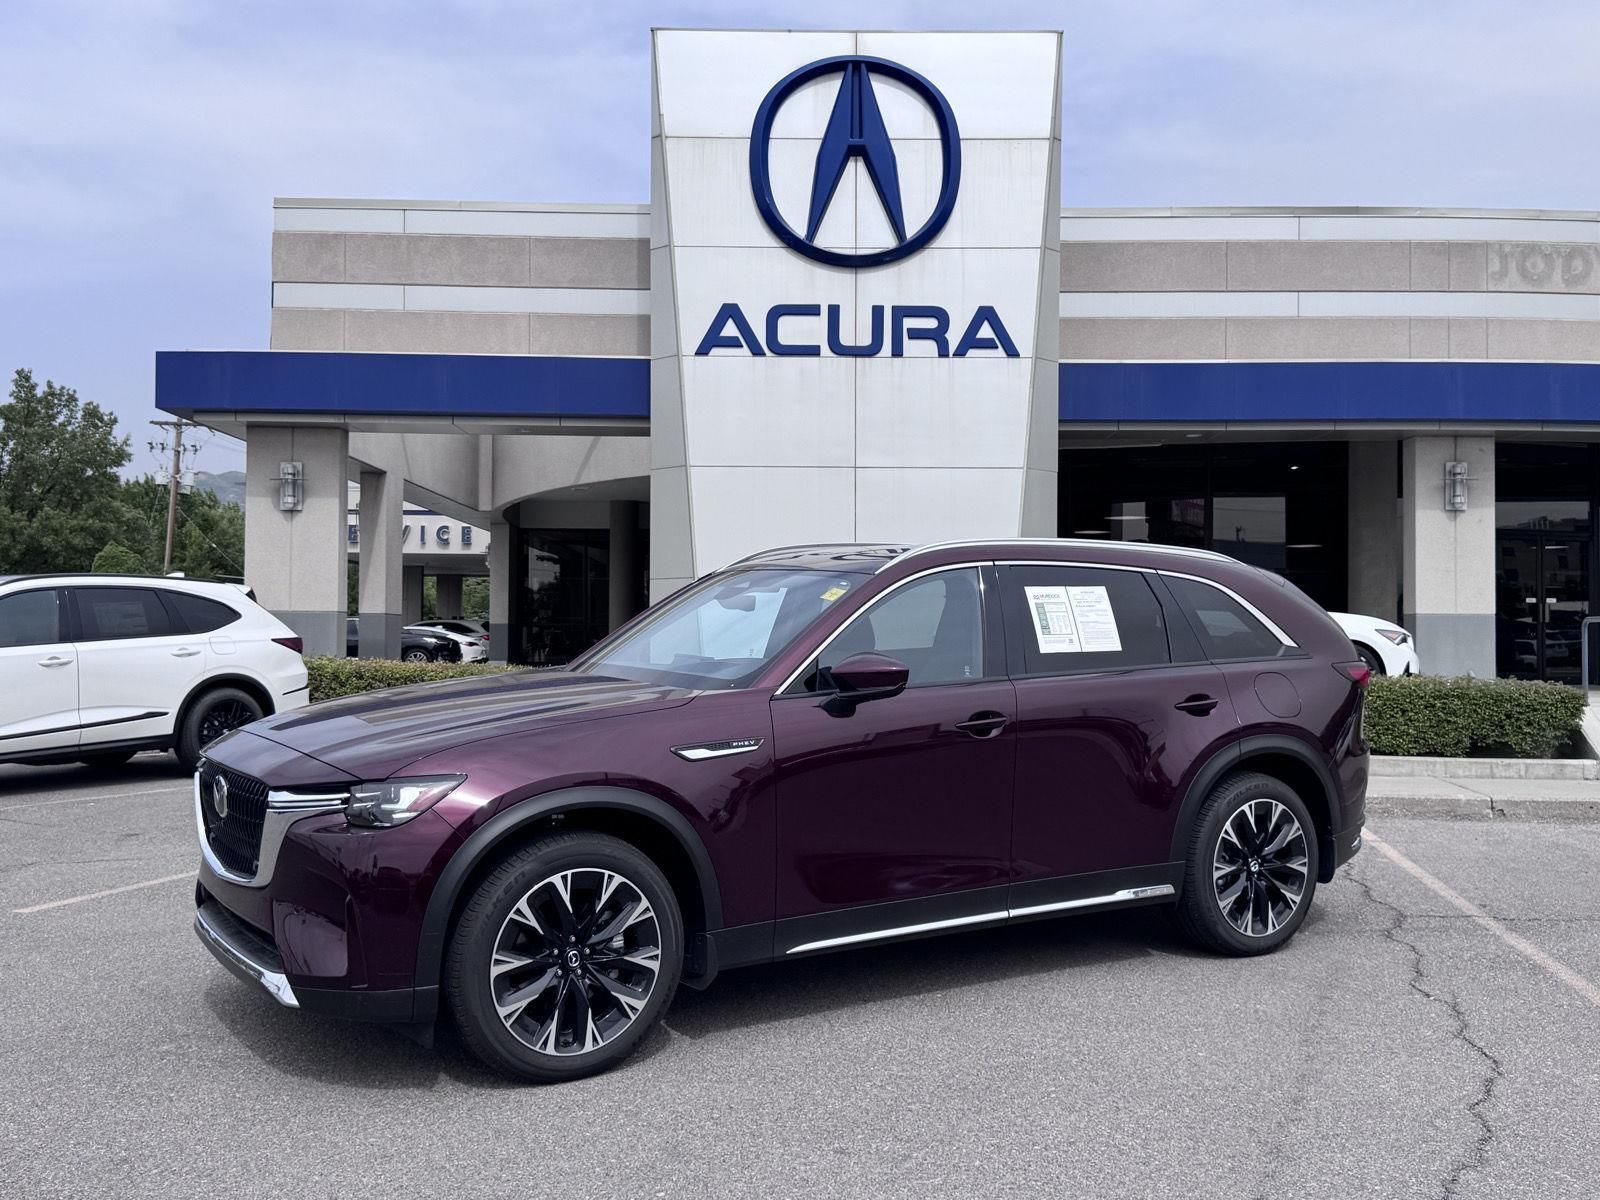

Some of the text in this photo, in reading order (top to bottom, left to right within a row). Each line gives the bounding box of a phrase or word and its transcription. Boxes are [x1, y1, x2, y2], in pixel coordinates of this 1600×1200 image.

[1488, 244, 1600, 288] JOD
[694, 303, 1020, 357] ACURA
[347, 524, 473, 545] EVICE
